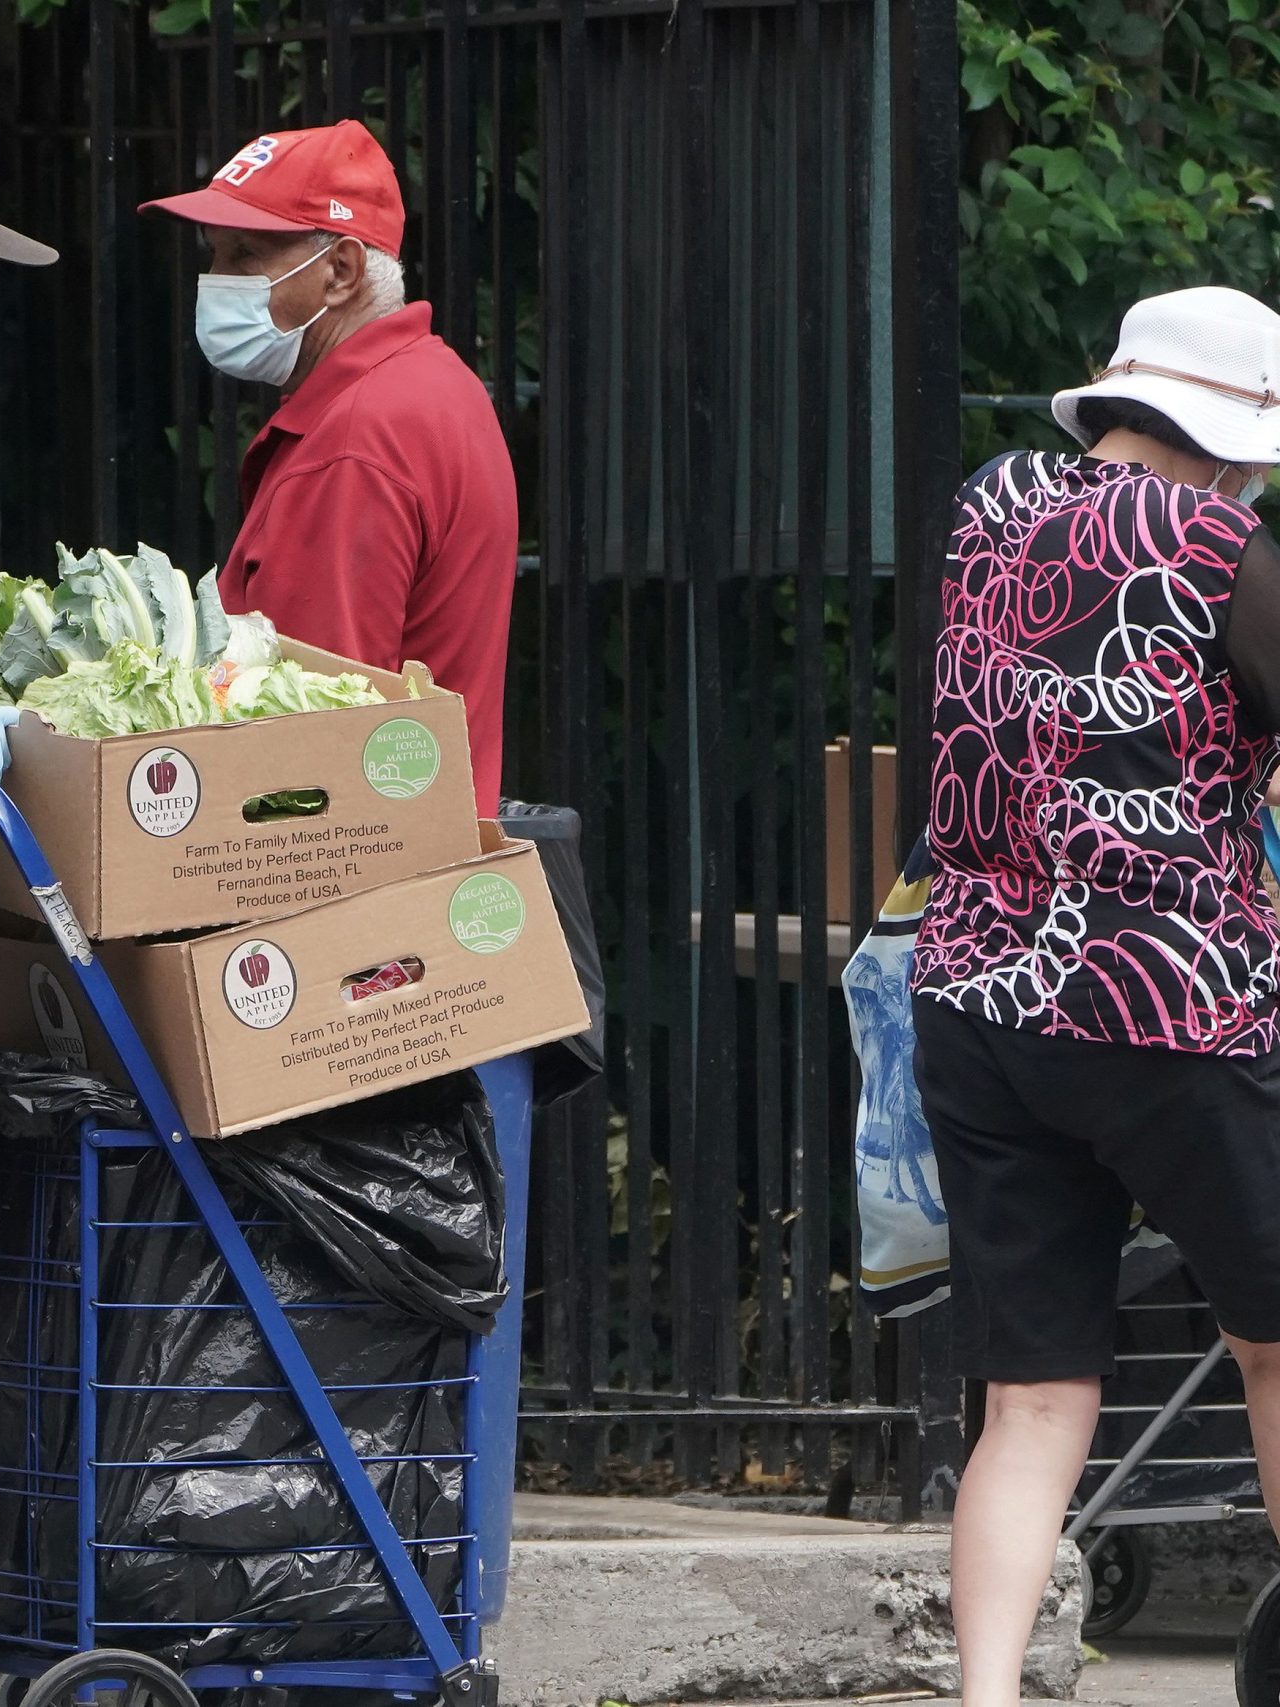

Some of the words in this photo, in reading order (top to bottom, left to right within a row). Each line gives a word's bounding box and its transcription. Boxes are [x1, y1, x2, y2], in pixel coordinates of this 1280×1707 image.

[377, 729, 420, 742] BECAUSE
[395, 740, 427, 751] LOCAL
[386, 750, 433, 762] MATTERS
[136, 796, 193, 814] UNITED
[145, 811, 185, 823] APPLE
[185, 845, 219, 858] Farm
[223, 840, 241, 853] To
[245, 835, 287, 850] Family
[291, 828, 330, 844] Mixed
[335, 824, 389, 839] Produce
[173, 858, 243, 879] Distributed
[247, 857, 262, 872] by
[266, 851, 313, 867] Perfect
[317, 846, 346, 860] Pact
[350, 841, 404, 857] Produce
[217, 873, 291, 892] Fernandina
[295, 866, 341, 882] Beach,
[345, 862, 362, 876] FL
[236, 893, 291, 909] Produce
[295, 888, 308, 901] of
[311, 884, 342, 899] USA
[459, 881, 502, 901] BECAUSE
[479, 891, 510, 906] LOCAL
[472, 900, 518, 920] MATTERS
[234, 984, 290, 1009] UNITED
[246, 999, 285, 1018] APPLE
[290, 1027, 325, 1046] Farm
[326, 1021, 345, 1034] To
[348, 1008, 389, 1029] Family
[392, 994, 431, 1016] Mixed
[434, 980, 487, 1004] Produce
[281, 1037, 350, 1068] Distributed
[352, 1034, 368, 1048] by
[371, 1018, 417, 1041] Perfect
[420, 1009, 449, 1027] Pact
[451, 995, 504, 1018] Produce
[328, 1045, 400, 1074] Fernandina
[402, 1031, 447, 1052] Beach,
[450, 1023, 468, 1038] FL
[349, 1063, 403, 1087] Produce
[406, 1055, 418, 1070] of
[421, 1047, 451, 1066] USA
